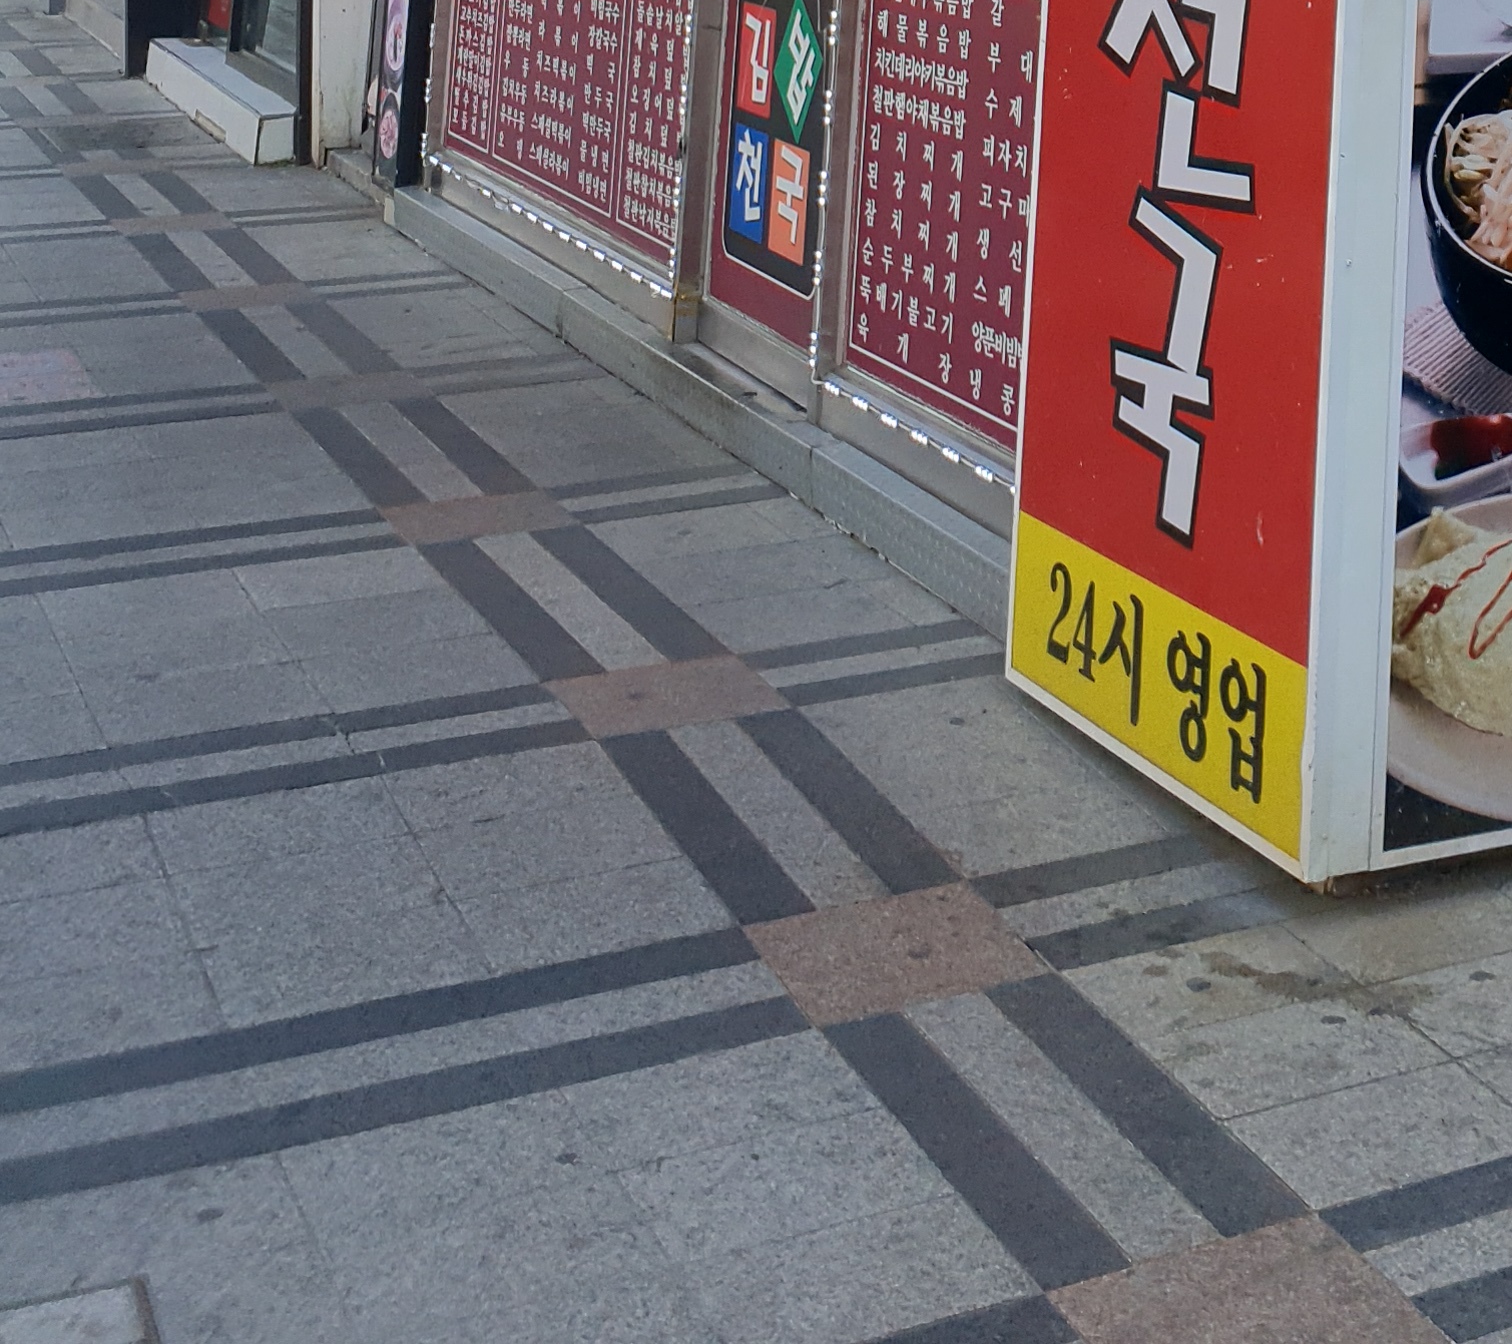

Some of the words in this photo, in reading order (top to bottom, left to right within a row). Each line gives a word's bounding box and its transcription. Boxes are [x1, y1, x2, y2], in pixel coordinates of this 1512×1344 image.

[877, 9, 971, 60] 해물볶음밥
[869, 123, 964, 183] 김치찌개
[866, 161, 961, 223] 된장찌개
[864, 199, 959, 263] 참치찌개
[861, 236, 957, 304] 순두부찌개
[857, 312, 952, 385] 육개장
[1047, 561, 1145, 730] 24시
[1166, 629, 1269, 803] 영업
